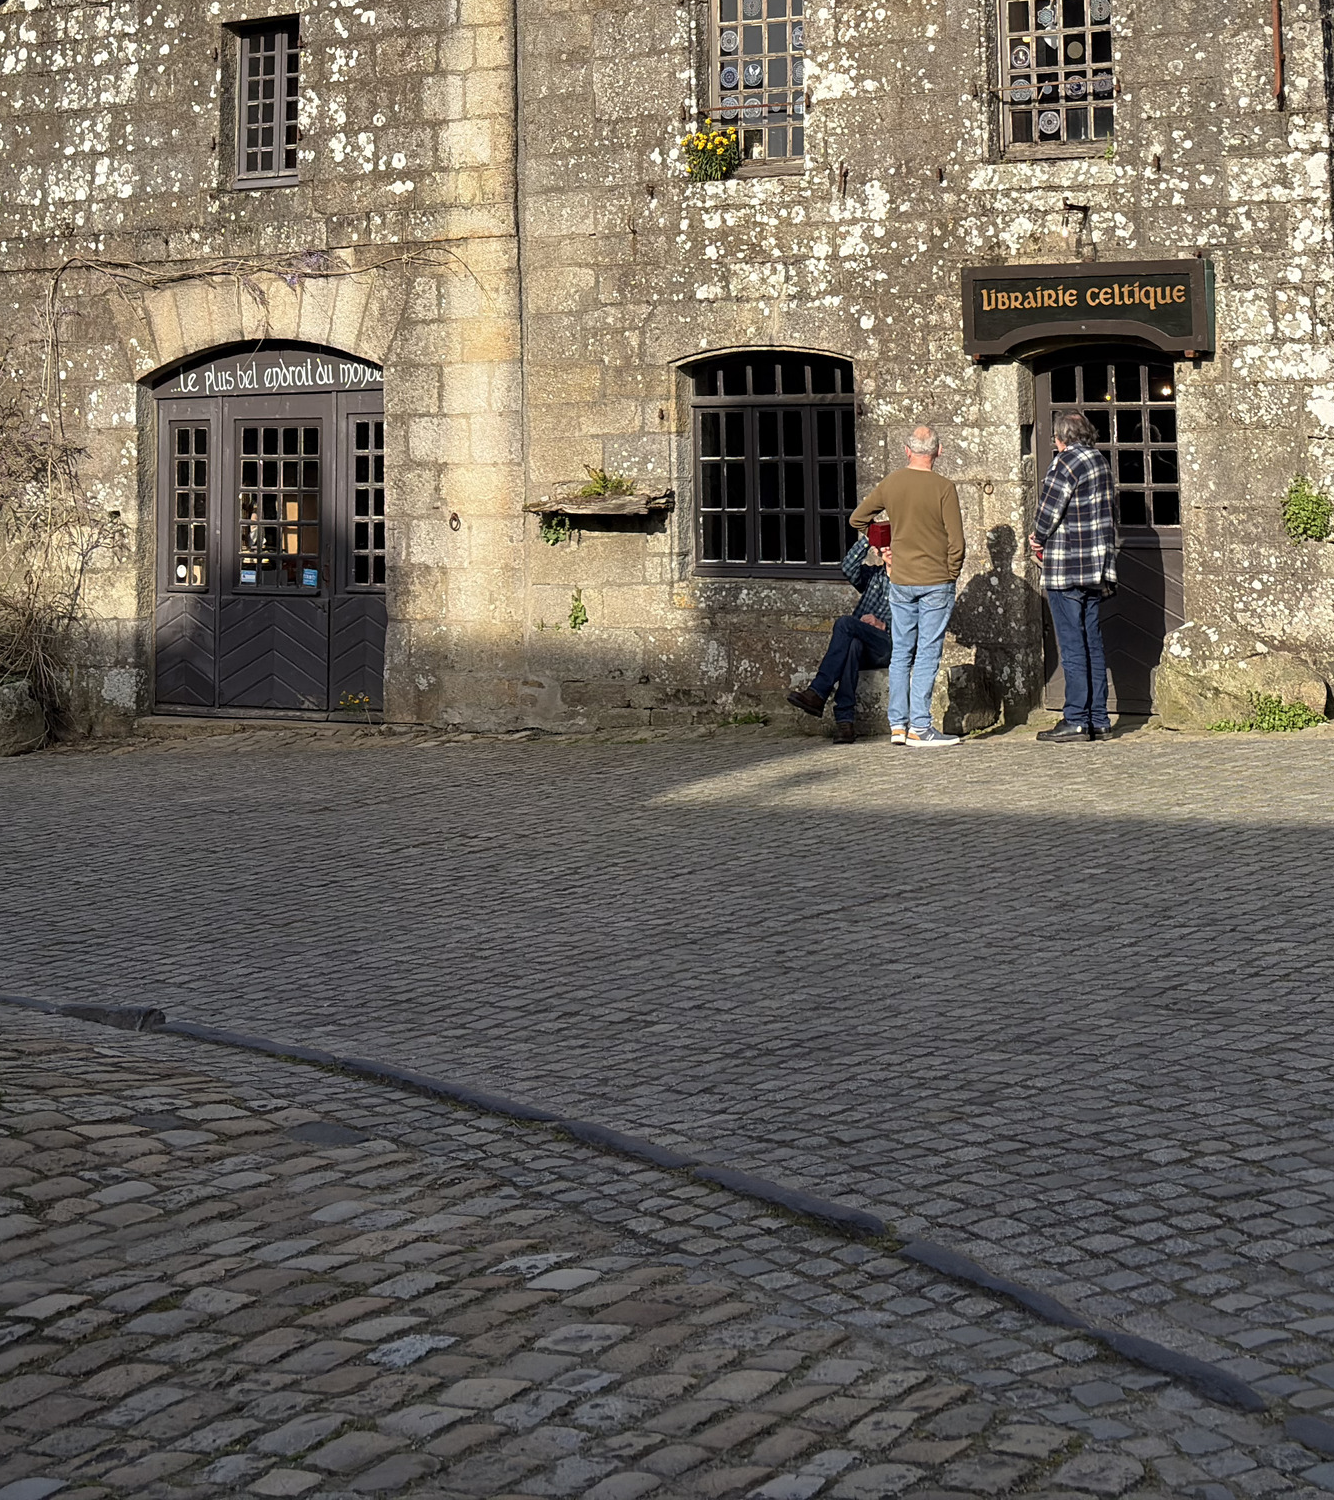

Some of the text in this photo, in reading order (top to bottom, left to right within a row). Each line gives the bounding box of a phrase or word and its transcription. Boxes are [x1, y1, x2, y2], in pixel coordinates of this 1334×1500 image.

[204, 364, 235, 395] plus
[237, 361, 259, 389] bel
[264, 358, 313, 392] endroit
[316, 357, 335, 386] du
